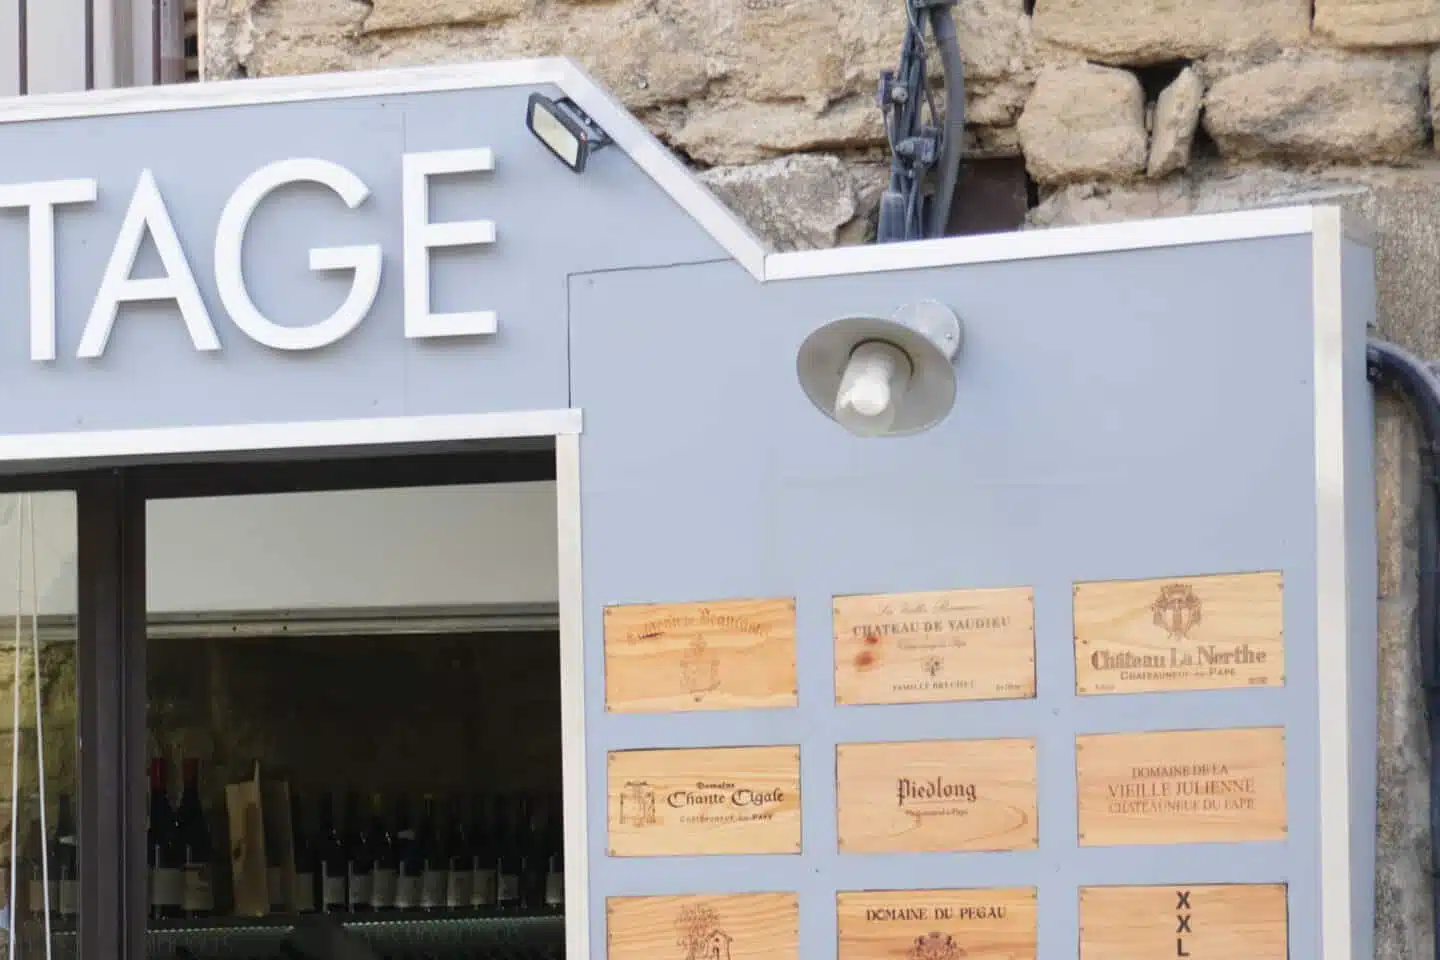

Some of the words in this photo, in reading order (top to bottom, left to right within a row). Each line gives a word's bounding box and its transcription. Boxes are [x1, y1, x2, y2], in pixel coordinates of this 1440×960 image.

[947, 616, 1011, 631] VAUDIEU
[1091, 648, 1166, 670] Château
[1169, 647, 1194, 666] La
[1196, 643, 1267, 666] Nerthe
[1131, 766, 1189, 779] DOMAINE
[1191, 765, 1210, 777] DE
[1210, 764, 1229, 775] LA
[696, 781, 736, 790] Domaine
[895, 776, 978, 807] Piedlong
[1107, 782, 1172, 799] VIEILLE
[1174, 777, 1257, 797] JULIENNE
[666, 791, 726, 808] Chante
[731, 787, 785, 806] Cigale
[1203, 799, 1221, 811] DU
[866, 907, 928, 921] DOMAINE
[934, 907, 954, 919] DU
